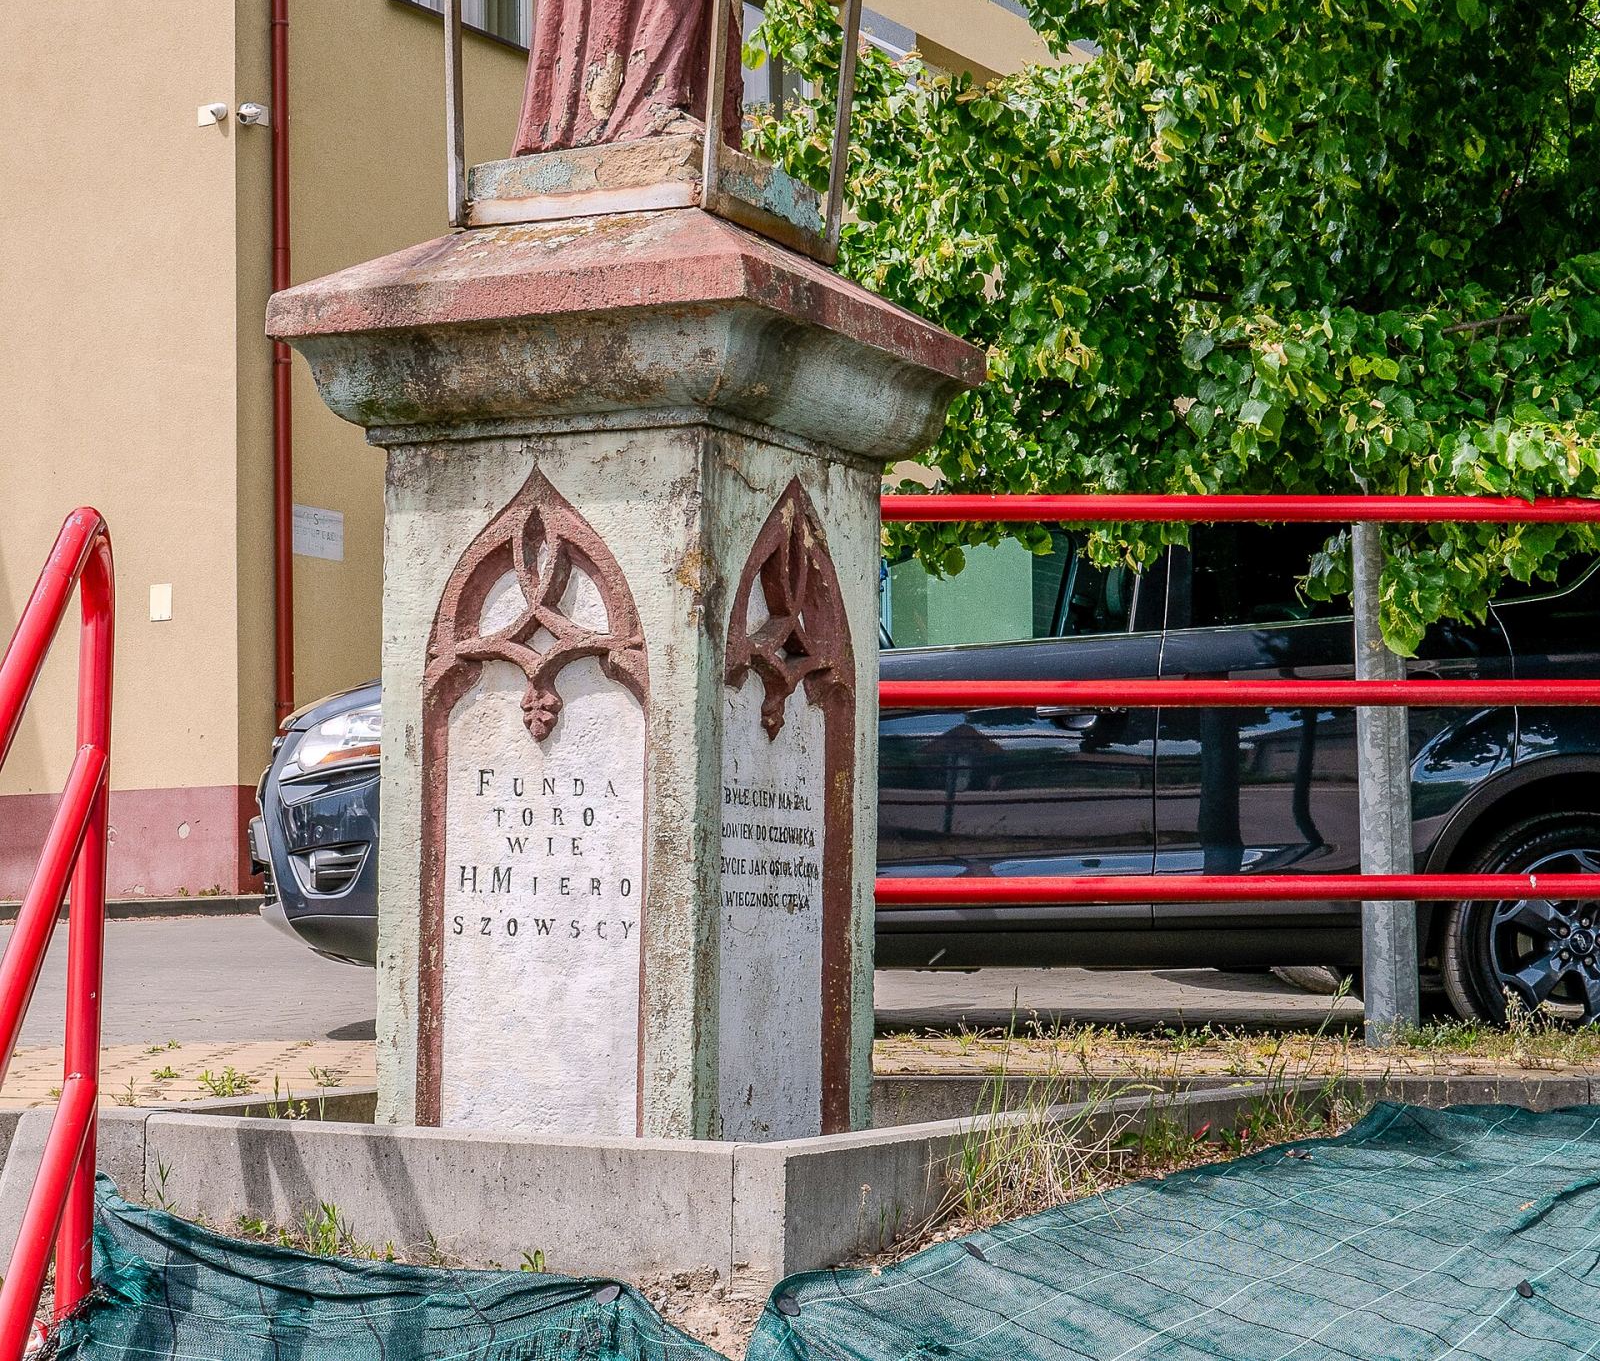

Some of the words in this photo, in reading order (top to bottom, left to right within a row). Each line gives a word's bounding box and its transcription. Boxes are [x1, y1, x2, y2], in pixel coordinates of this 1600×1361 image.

[476, 769, 619, 797] FUNDA
[724, 786, 749, 806] BYLE
[493, 807, 595, 827] TORO
[721, 822, 754, 840] ŁOWIEK
[756, 825, 767, 841] DO
[506, 837, 583, 857] WIE
[749, 859, 768, 876] JAK
[453, 916, 635, 940] SZOWSCY
